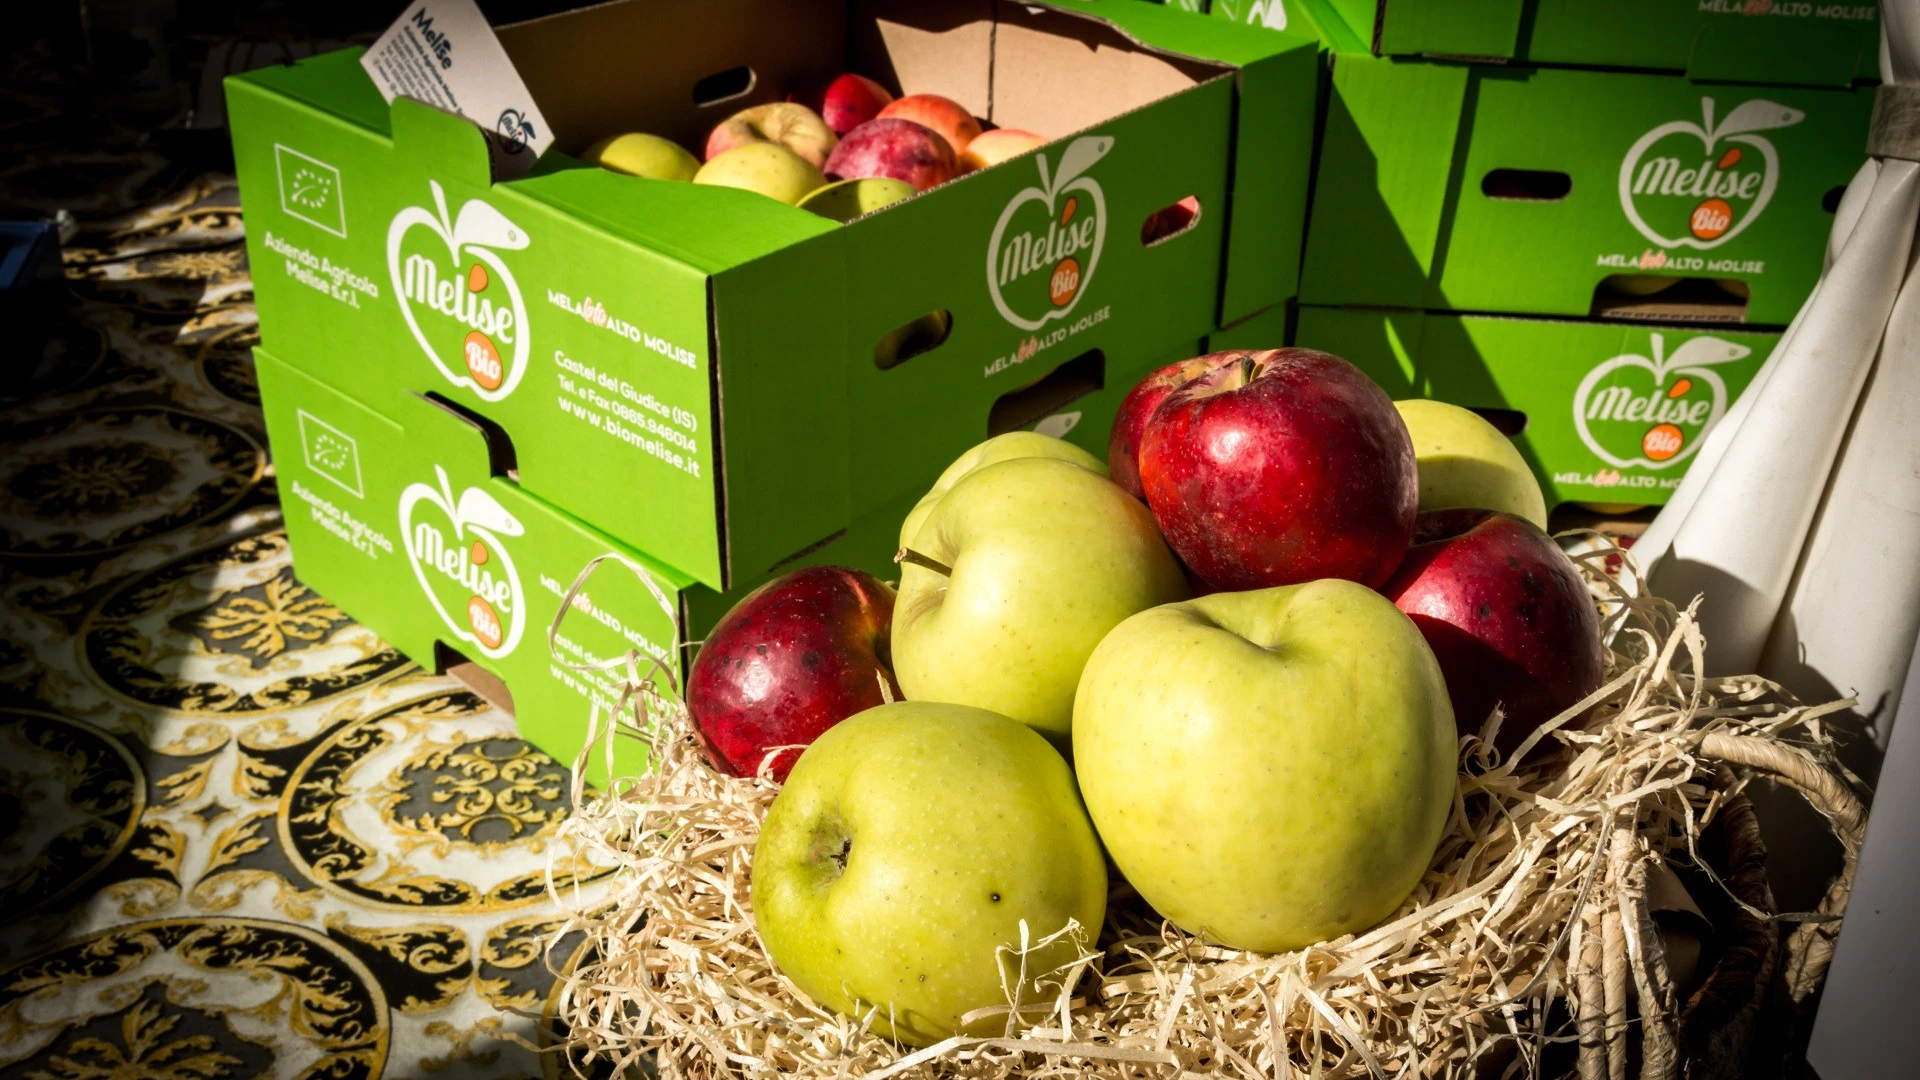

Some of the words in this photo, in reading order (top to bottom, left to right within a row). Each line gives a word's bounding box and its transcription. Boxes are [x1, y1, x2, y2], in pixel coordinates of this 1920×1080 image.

[1815, 5, 1876, 21] MOLISE
[411, 6, 453, 70] Melise
[1632, 148, 1762, 200] Melise
[1692, 207, 1730, 231] Bio
[1000, 196, 1095, 287] Melise
[264, 231, 320, 270] Azienda
[321, 257, 379, 298] Agricola
[285, 259, 329, 294] Melise
[1051, 268, 1079, 299] Bio
[1706, 259, 1765, 274] MOLISE
[405, 253, 513, 344] Melise
[1069, 304, 1111, 336] MOLISE
[465, 341, 501, 381] Bio
[644, 332, 697, 370] MOLISE
[554, 350, 596, 382] Castel
[597, 372, 618, 393] del
[619, 381, 671, 418] Giudice
[671, 406, 698, 433] (IS)
[558, 373, 578, 396] Tel.
[578, 387, 587, 400] e
[587, 388, 611, 411] Fax
[1587, 378, 1711, 426] Melise
[1643, 430, 1682, 453] Bio
[415, 522, 511, 613] Melise
[469, 603, 501, 642] Bio
